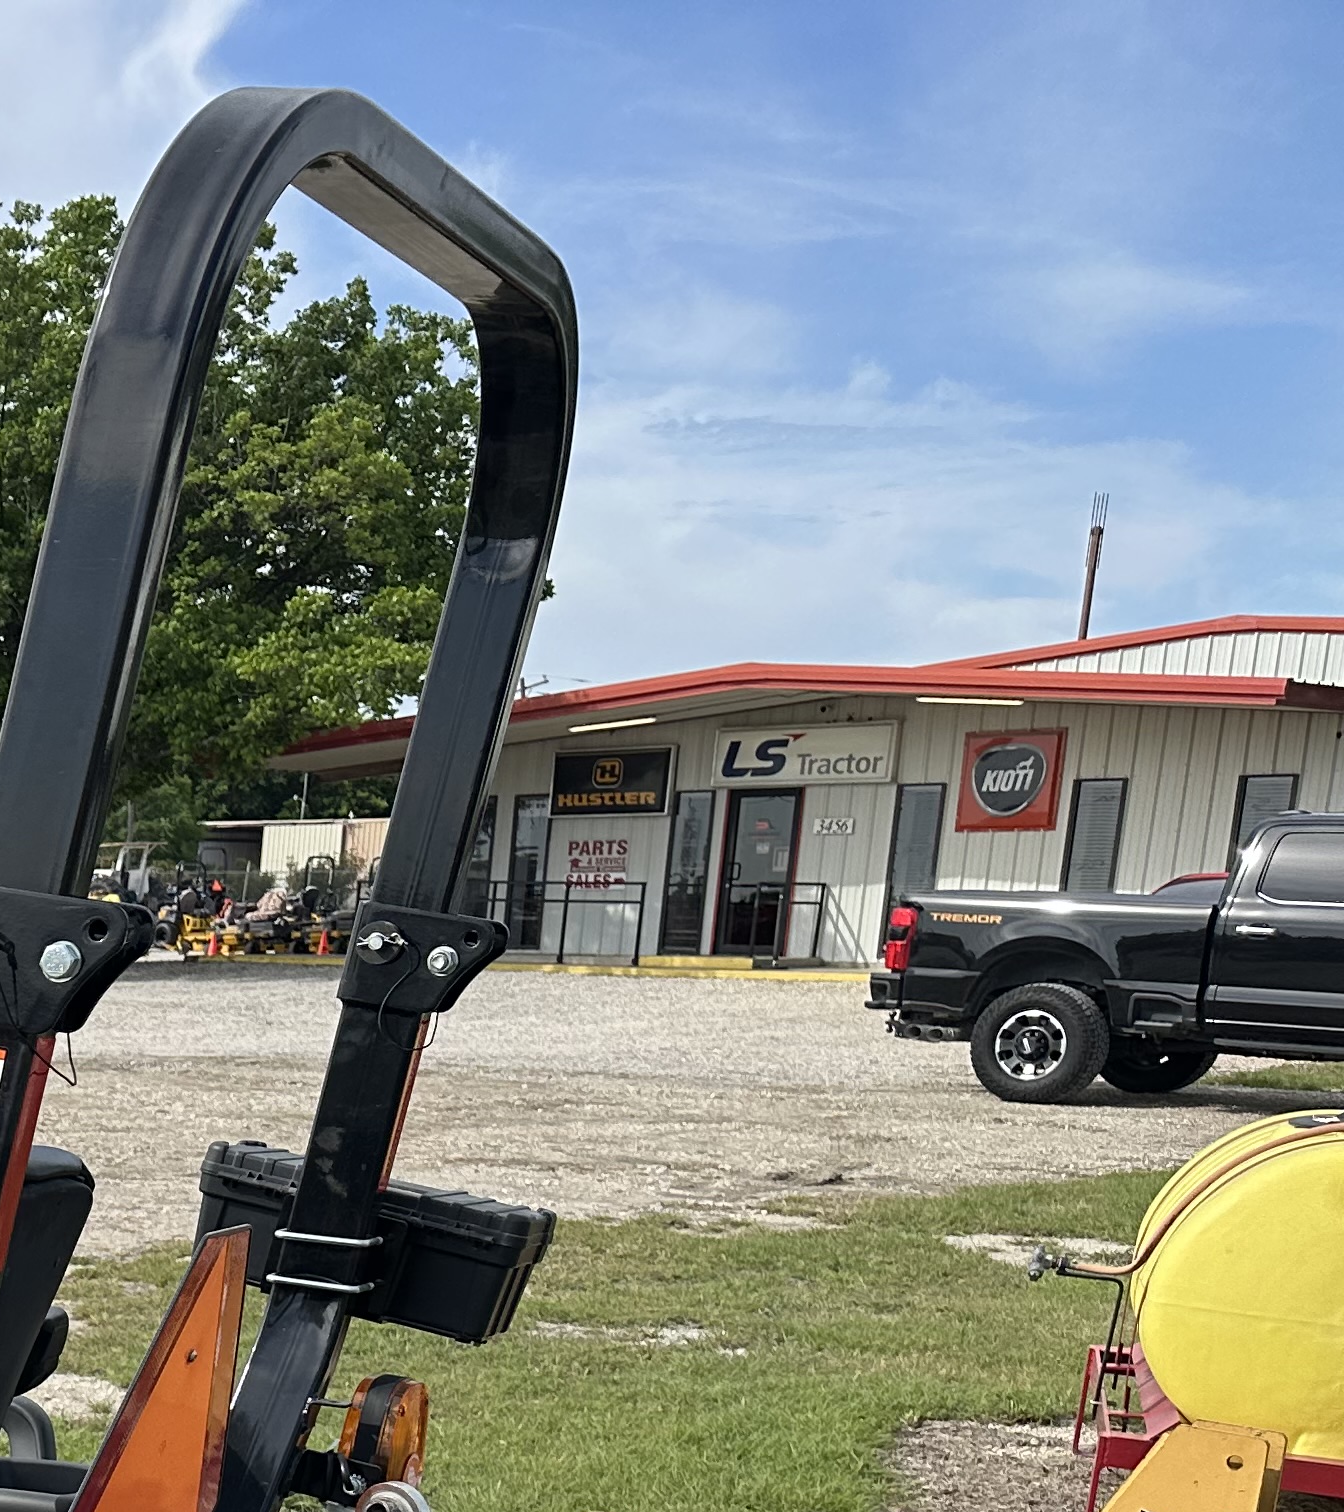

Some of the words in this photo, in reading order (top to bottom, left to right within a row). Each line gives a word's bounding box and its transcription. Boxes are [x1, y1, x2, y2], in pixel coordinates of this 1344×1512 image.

[721, 739, 790, 778] LS
[797, 753, 884, 776] Tractor
[981, 768, 1034, 792] KIOTI
[558, 791, 657, 808] HUSTLER
[568, 839, 628, 857] PARTS
[595, 856, 626, 866] SERVICE
[566, 873, 612, 888] SALES
[930, 911, 1003, 925] TREMOR
